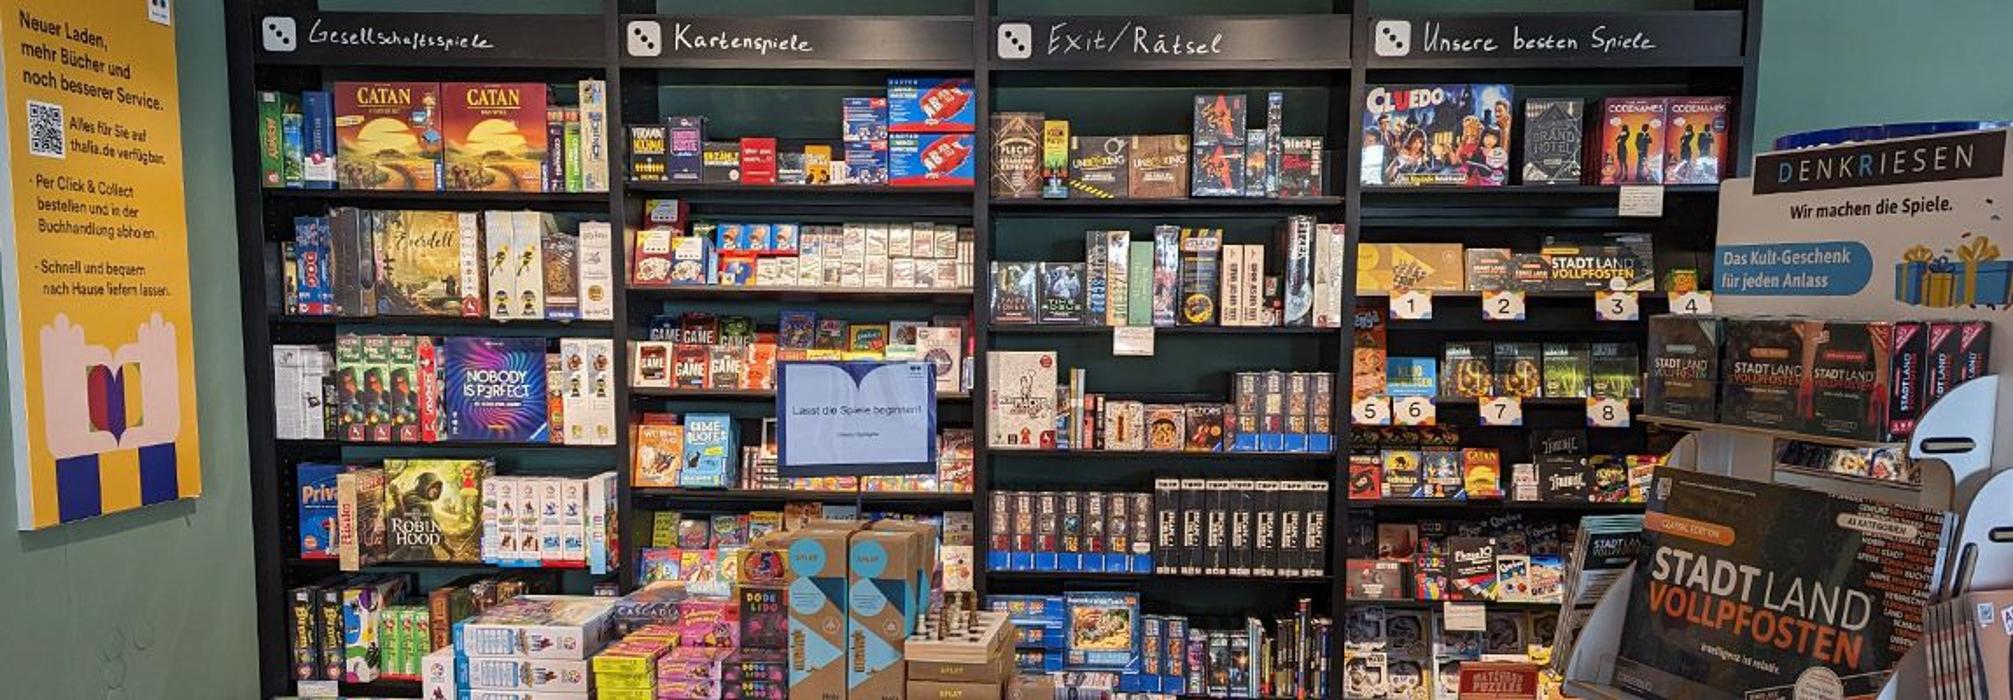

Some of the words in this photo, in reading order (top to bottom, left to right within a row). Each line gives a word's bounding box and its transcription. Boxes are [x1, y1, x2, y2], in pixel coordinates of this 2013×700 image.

[19, 10, 61, 36] Neuer
[65, 23, 108, 52] Laden,
[308, 18, 495, 50] Gesellschaftsspiele
[674, 23, 814, 55] Kartenspiele
[1424, 21, 1499, 51] Unsere
[1513, 25, 1578, 50] besten
[1591, 25, 1656, 50] Spiele
[21, 40, 57, 62] mehr
[60, 47, 105, 74] Bücher
[108, 62, 131, 80] und
[23, 69, 57, 90] noch
[60, 77, 114, 101] besserer
[116, 87, 164, 111] Service.
[357, 86, 411, 105] CATAN
[466, 88, 520, 106] CATAN
[1366, 87, 1444, 114] CLUEDO
[1608, 104, 1664, 113] CODENAMES
[1671, 104, 1727, 113] CODENAMES
[69, 116, 95, 134] Alles
[97, 119, 113, 138] für
[114, 124, 130, 140] Sie
[131, 130, 148, 143] auf
[70, 138, 115, 159] thalia.de
[1778, 144, 1975, 184] DENKRIESEN
[36, 174, 55, 191] Per
[57, 175, 85, 194] Click
[87, 180, 96, 194] &
[98, 181, 134, 199] Collect
[37, 198, 87, 215] bestellen
[89, 201, 109, 216] und
[110, 204, 121, 217] in
[122, 205, 139, 219] der
[1790, 203, 1813, 220] Wir
[1815, 198, 1871, 218] machen
[1876, 197, 1898, 215] die
[1901, 196, 1953, 219] Spiele.
[38, 218, 115, 240] Buchhandlung
[1552, 257, 1594, 269] STADT
[1596, 256, 1634, 269] LAND
[1723, 250, 1747, 266] Das
[1750, 249, 1851, 266] Kult-Geschenk
[41, 259, 82, 277] Schnell
[83, 261, 104, 277] und
[106, 262, 145, 280] bequem
[1552, 269, 1634, 279] VOLLPFOSTEN
[1721, 272, 1741, 289] für
[1743, 272, 1780, 290] jeden
[1783, 273, 1829, 288] Anlass
[43, 282, 70, 297] nach
[71, 283, 105, 298] Hause
[106, 283, 138, 298] liefern
[1407, 298, 1414, 313] 1
[1498, 298, 1510, 314] 2
[1611, 299, 1623, 314] 3
[1685, 299, 1698, 314] 4
[712, 359, 741, 373] GAME
[1655, 357, 1682, 369] STADT
[1734, 361, 1770, 375] STADT
[466, 370, 528, 384] NOBODY
[1814, 368, 1844, 380] STADT
[463, 384, 475, 397] IS
[792, 406, 820, 416] Lasst
[822, 405, 837, 416] die
[840, 405, 871, 417] Spiele
[1364, 403, 1376, 419] 5
[1409, 402, 1421, 418] 6
[1494, 404, 1507, 419] 7
[1602, 405, 1614, 420] 8
[392, 518, 441, 534] ROBIN
[396, 533, 440, 545] HOOD
[1652, 546, 1761, 603] STADT
[1763, 571, 1871, 631] LAND
[1648, 580, 1864, 670] VOLLPFOSTEN
